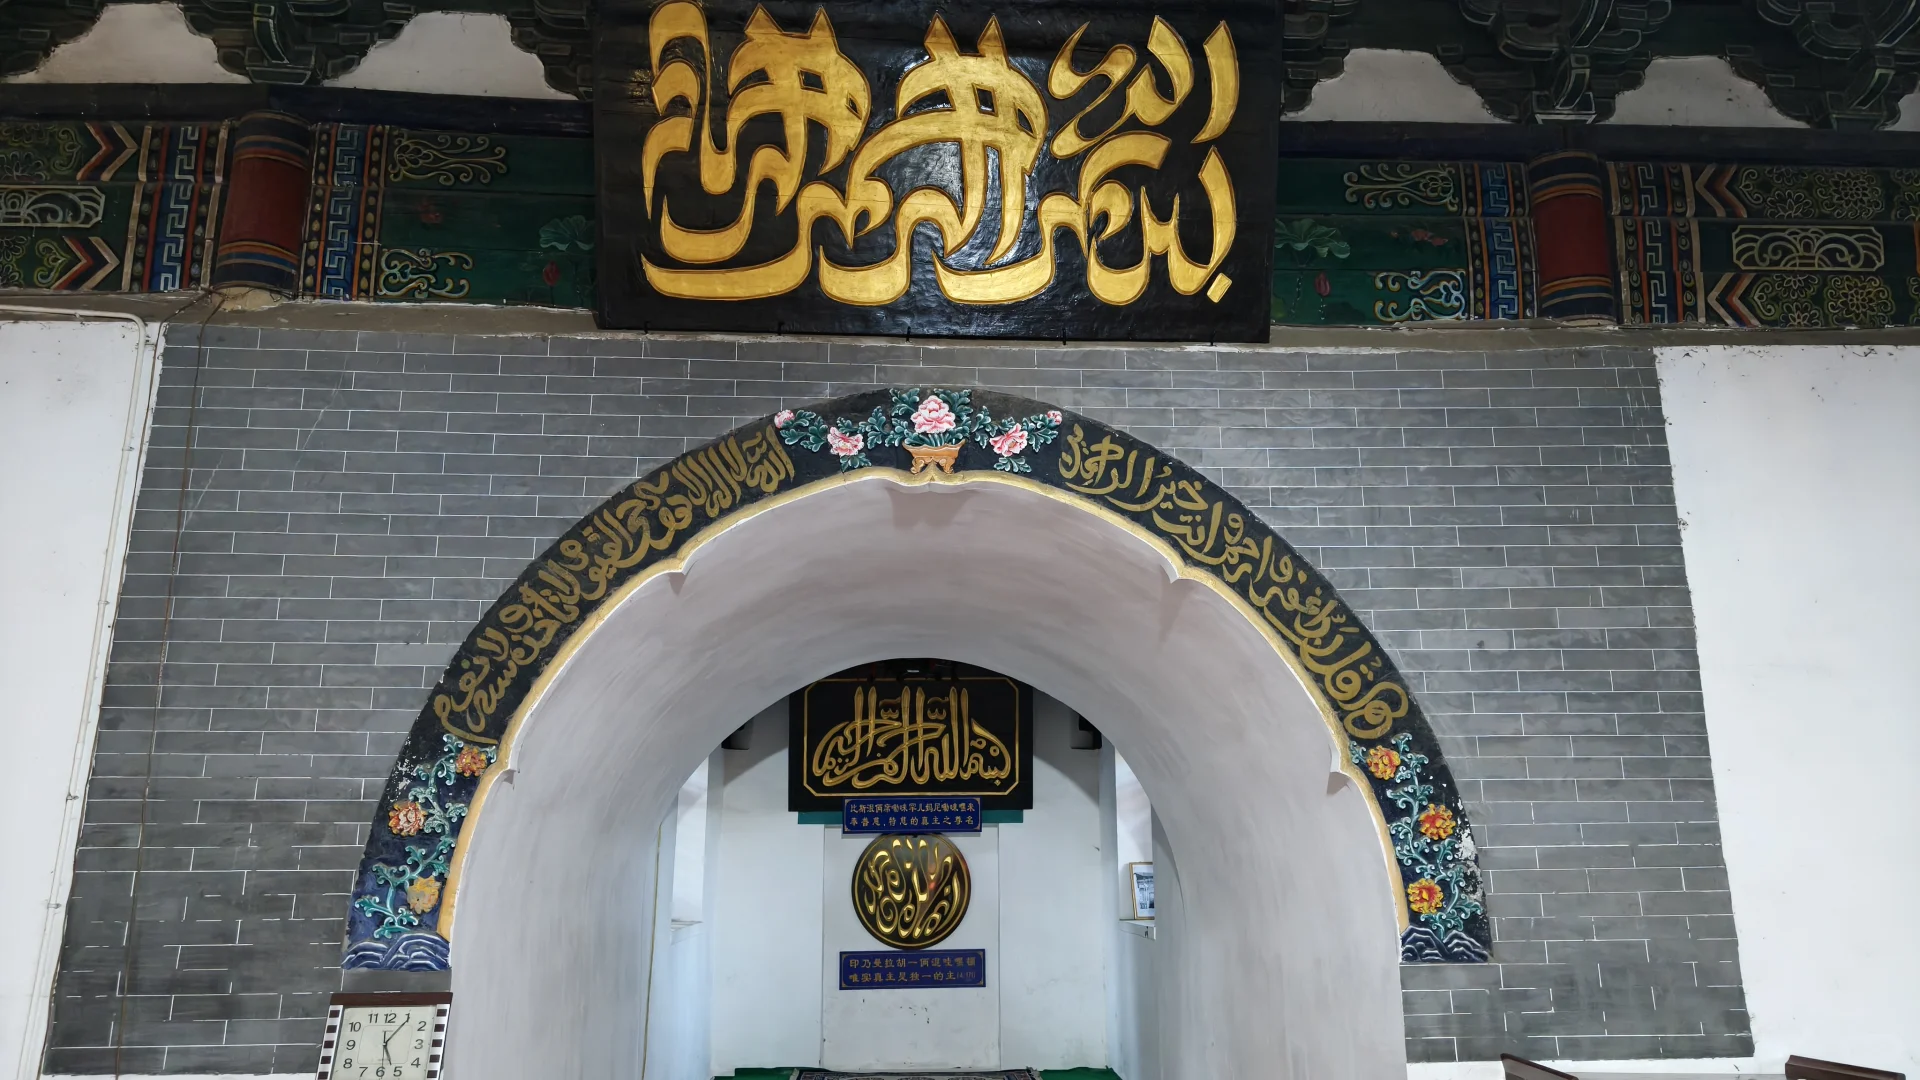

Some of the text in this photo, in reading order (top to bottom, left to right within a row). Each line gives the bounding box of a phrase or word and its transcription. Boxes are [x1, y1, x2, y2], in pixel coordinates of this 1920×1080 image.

[368, 1013, 379, 1023] 11
[384, 1013, 397, 1023] 12
[349, 1021, 361, 1032] 10
[417, 1021, 427, 1031] 2
[346, 1039, 356, 1051] 9
[414, 1039, 424, 1050] 3
[343, 1058, 353, 1069] 8
[410, 1057, 421, 1068] 4
[359, 1066, 368, 1077] 7
[375, 1067, 385, 1077] 6
[393, 1066, 402, 1077] 5
